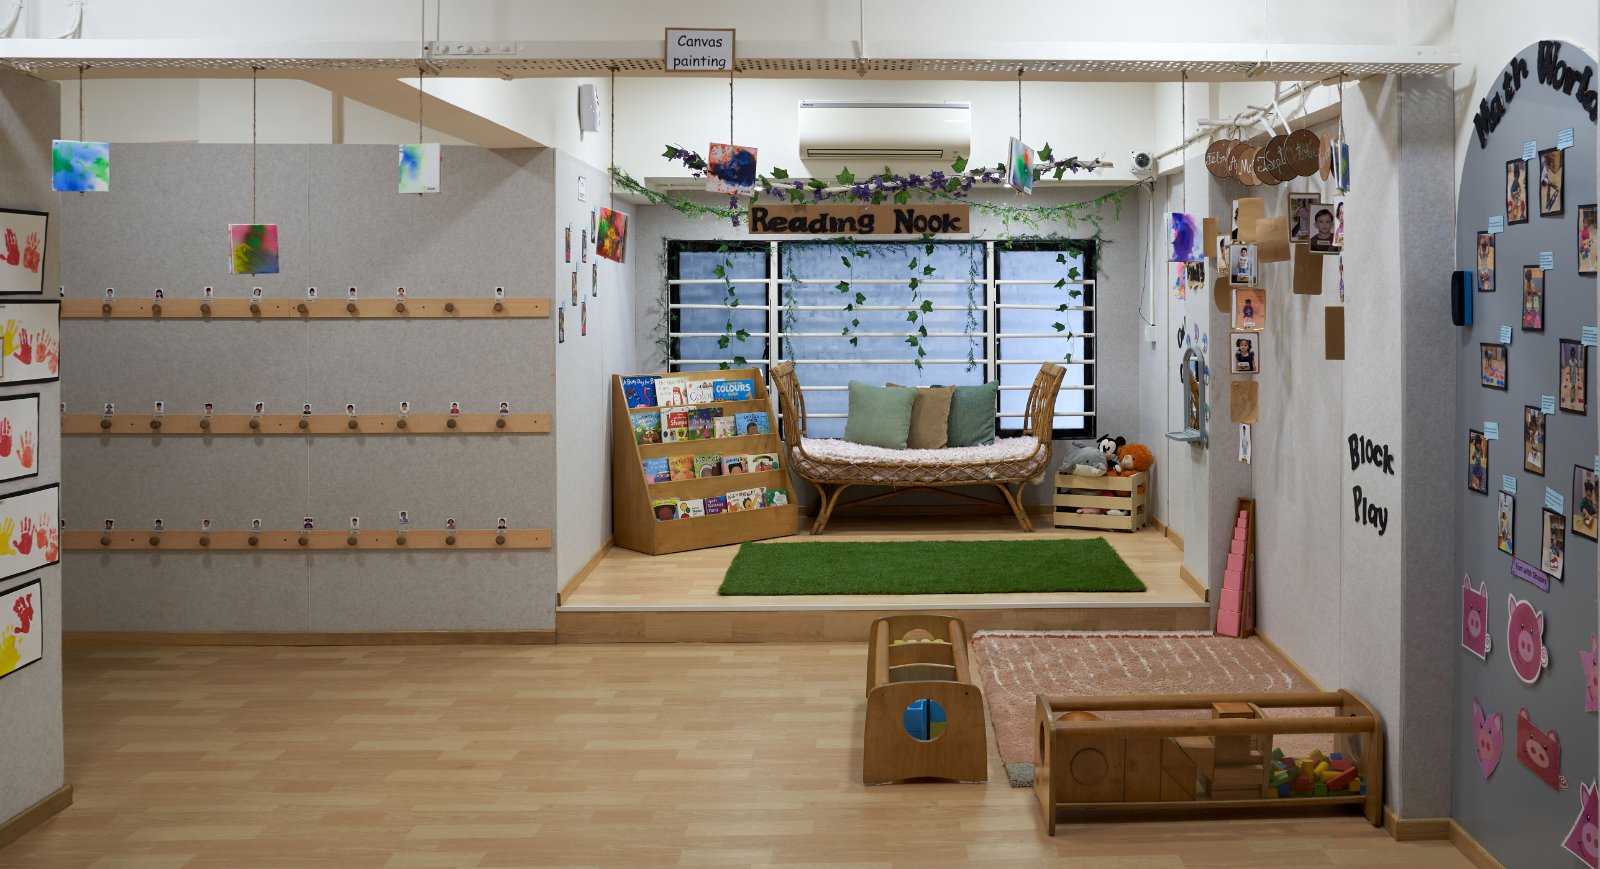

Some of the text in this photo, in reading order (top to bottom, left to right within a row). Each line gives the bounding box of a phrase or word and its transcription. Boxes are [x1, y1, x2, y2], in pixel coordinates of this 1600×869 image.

[677, 34, 723, 48] Canvas
[673, 55, 727, 70] painting
[1472, 56, 1529, 150] Math
[751, 207, 962, 234] Reading Nook
[637, 379, 645, 387] Day
[716, 383, 752, 393] COLOURS
[1348, 433, 1394, 475] Block
[1352, 485, 1388, 536] Play
[1532, 571, 1547, 584] Shapes
